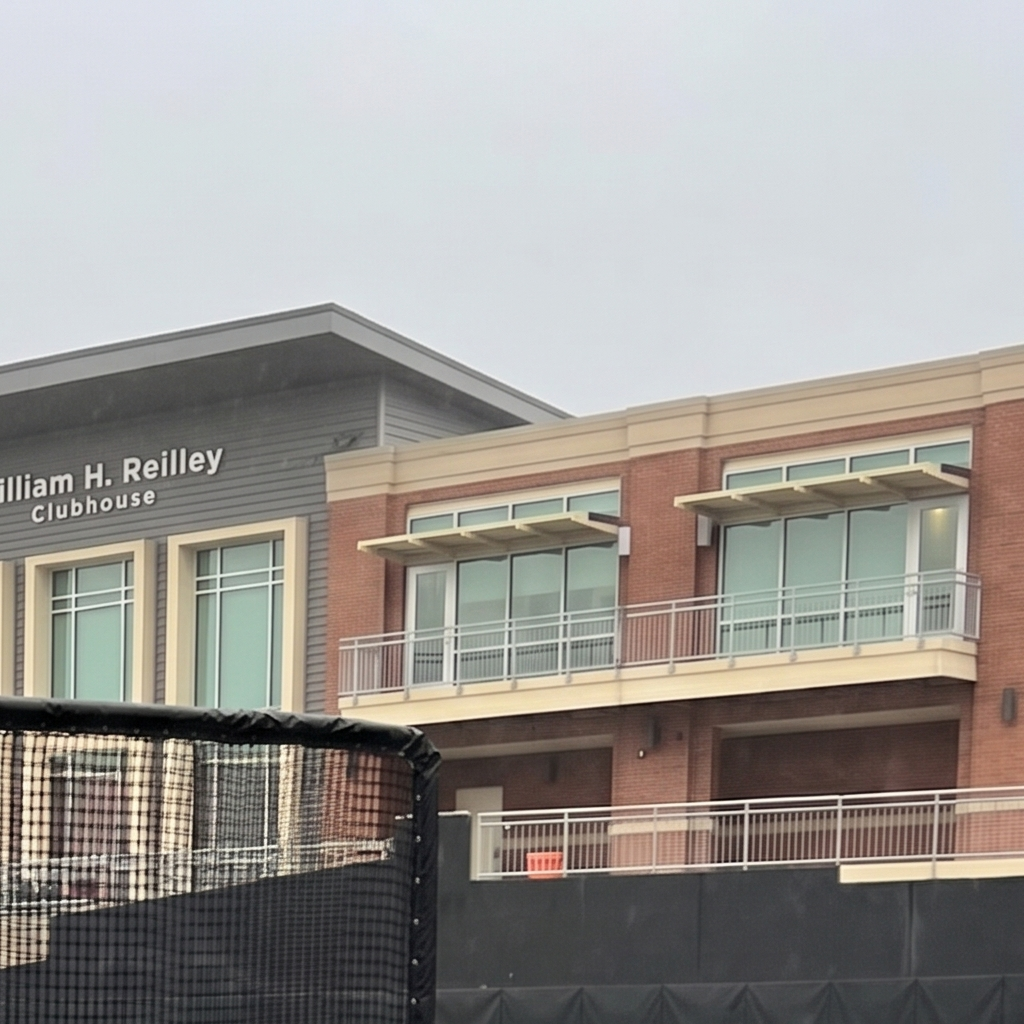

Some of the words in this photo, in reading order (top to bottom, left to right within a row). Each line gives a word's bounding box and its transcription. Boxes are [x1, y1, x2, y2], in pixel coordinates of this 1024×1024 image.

[83, 462, 113, 490] H.
[122, 447, 224, 484] Reilley
[30, 488, 156, 524] Clubhouse
